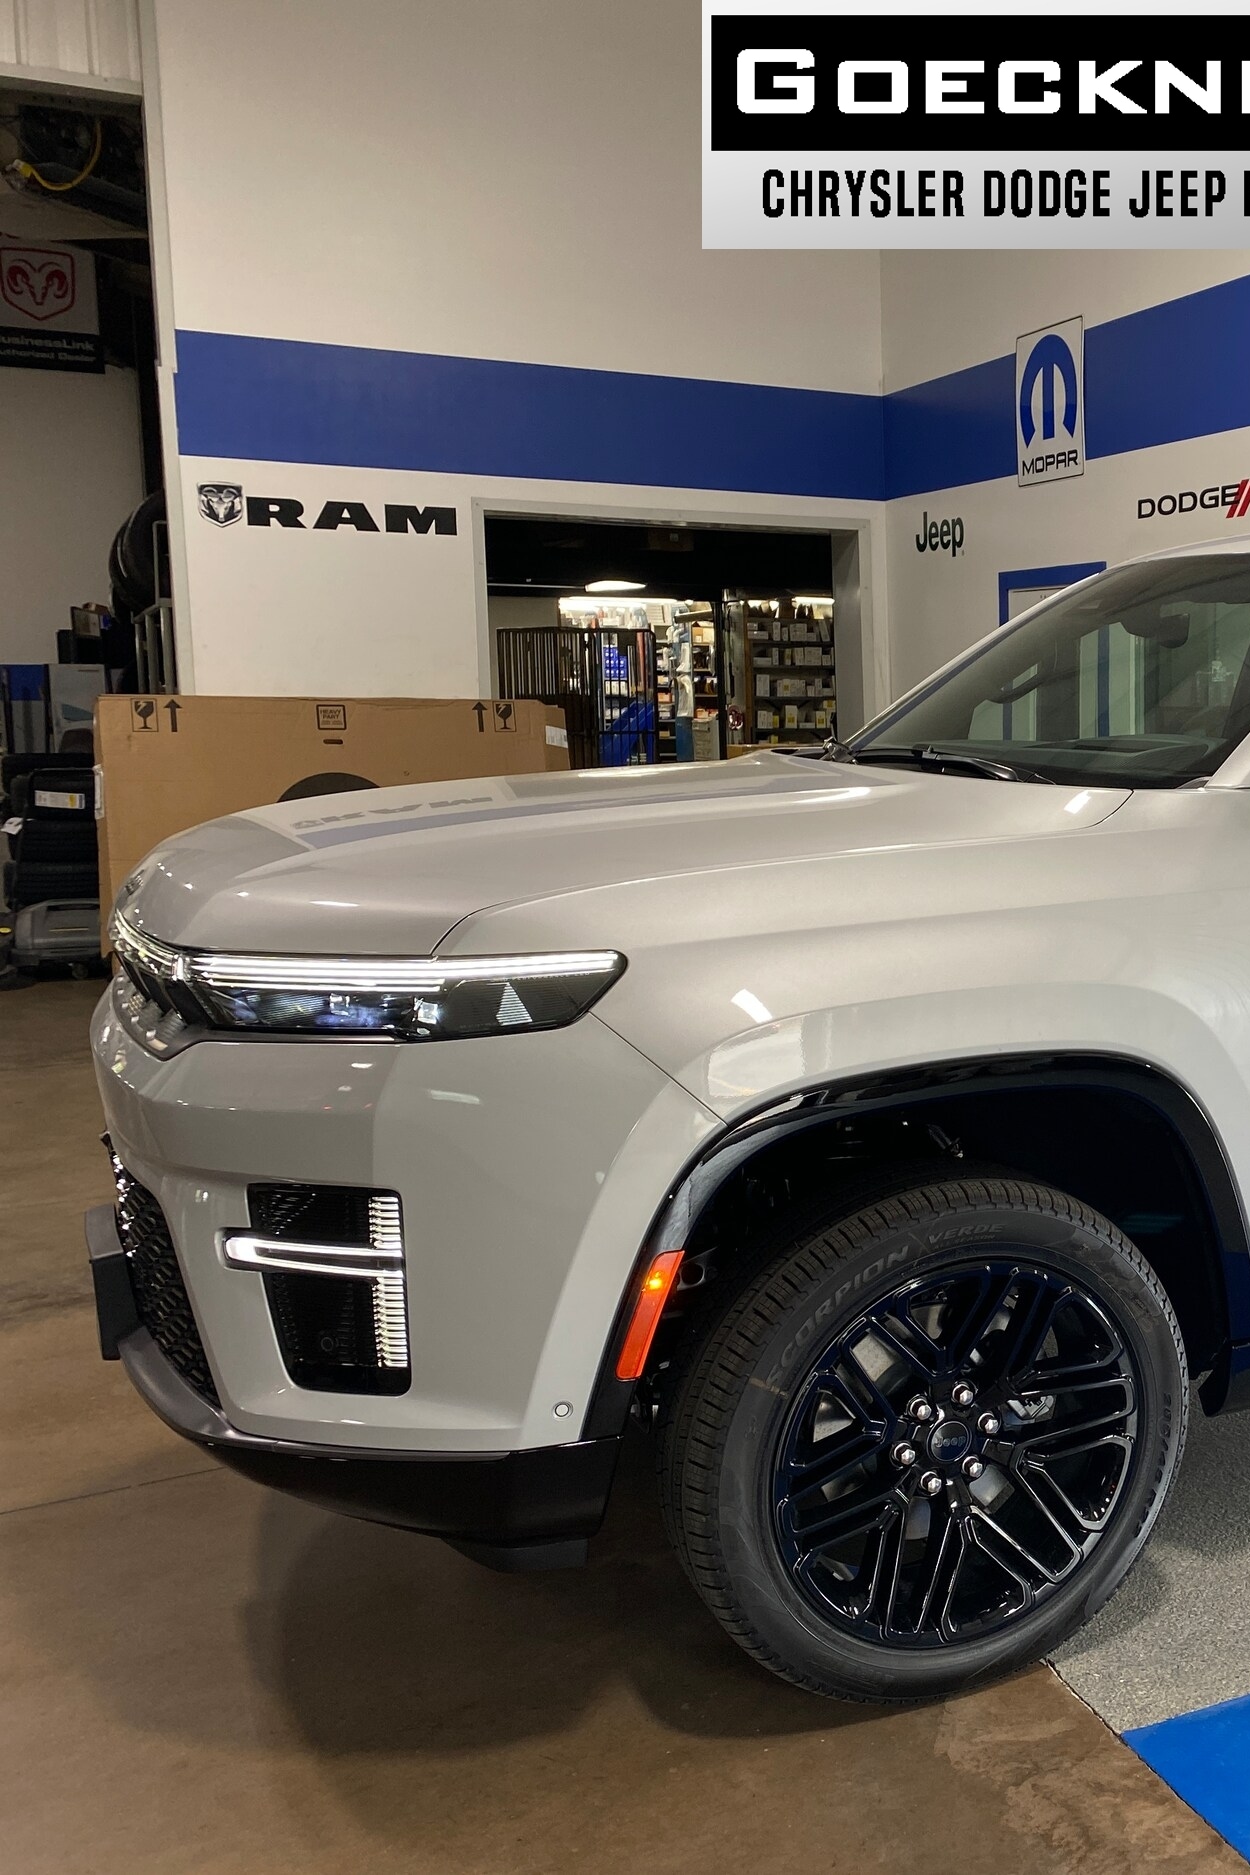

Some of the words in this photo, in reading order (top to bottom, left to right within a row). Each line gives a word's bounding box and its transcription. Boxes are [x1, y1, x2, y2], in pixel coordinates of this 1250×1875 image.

[0, 335, 96, 352] usinessLink
[1021, 449, 1079, 476] MOPAR
[245, 496, 458, 536] RAM
[1137, 483, 1242, 519] DODGE
[915, 511, 965, 557] Jeep
[765, 1244, 910, 1385] SCORPION
[927, 1222, 1006, 1246] VERDE
[934, 1435, 967, 1449] Jeep
